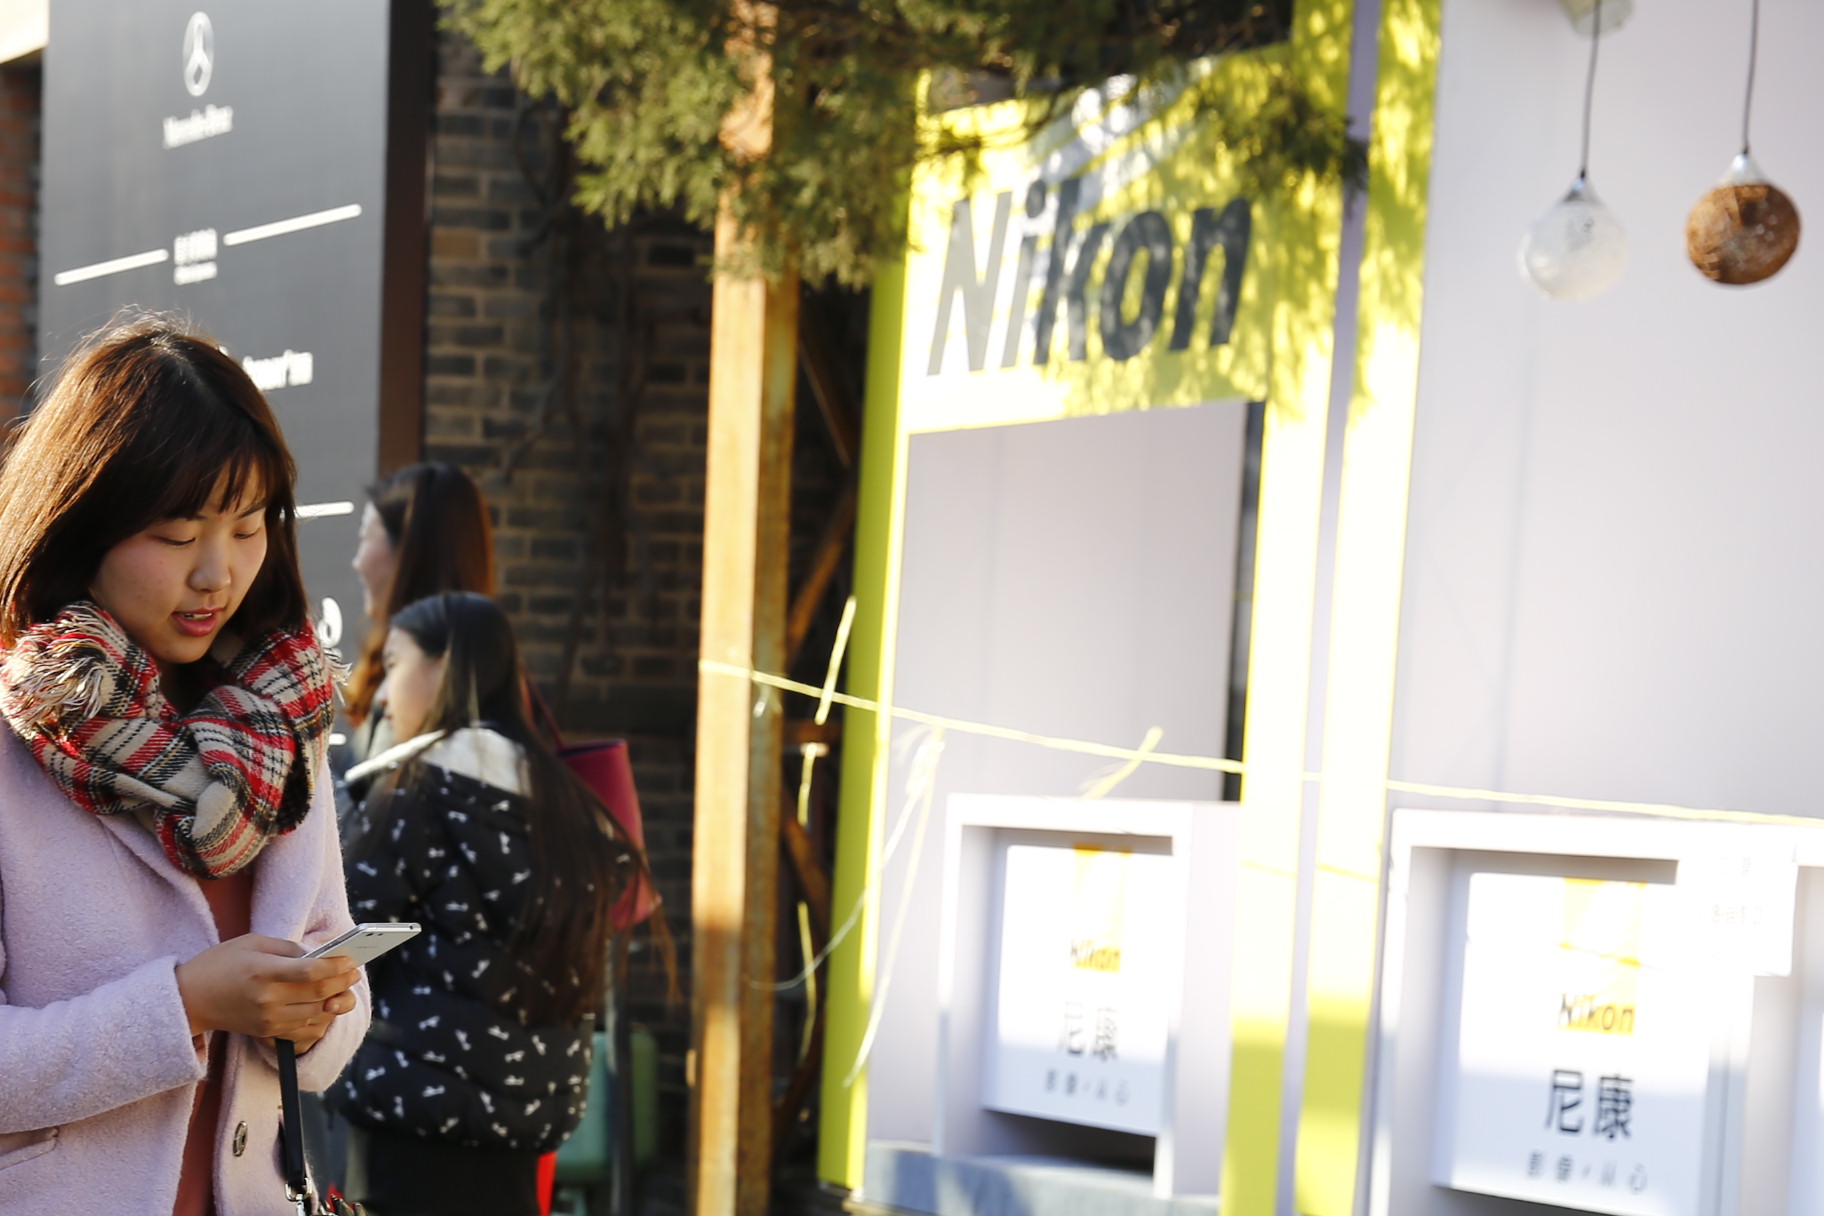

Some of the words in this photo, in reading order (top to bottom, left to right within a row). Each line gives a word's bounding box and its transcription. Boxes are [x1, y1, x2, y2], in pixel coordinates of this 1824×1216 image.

[928, 179, 1251, 376] Nikon
[1058, 1001, 1118, 1061] 尼康
[1559, 994, 1635, 1033] Nikon
[1545, 1069, 1635, 1139] 尼康
